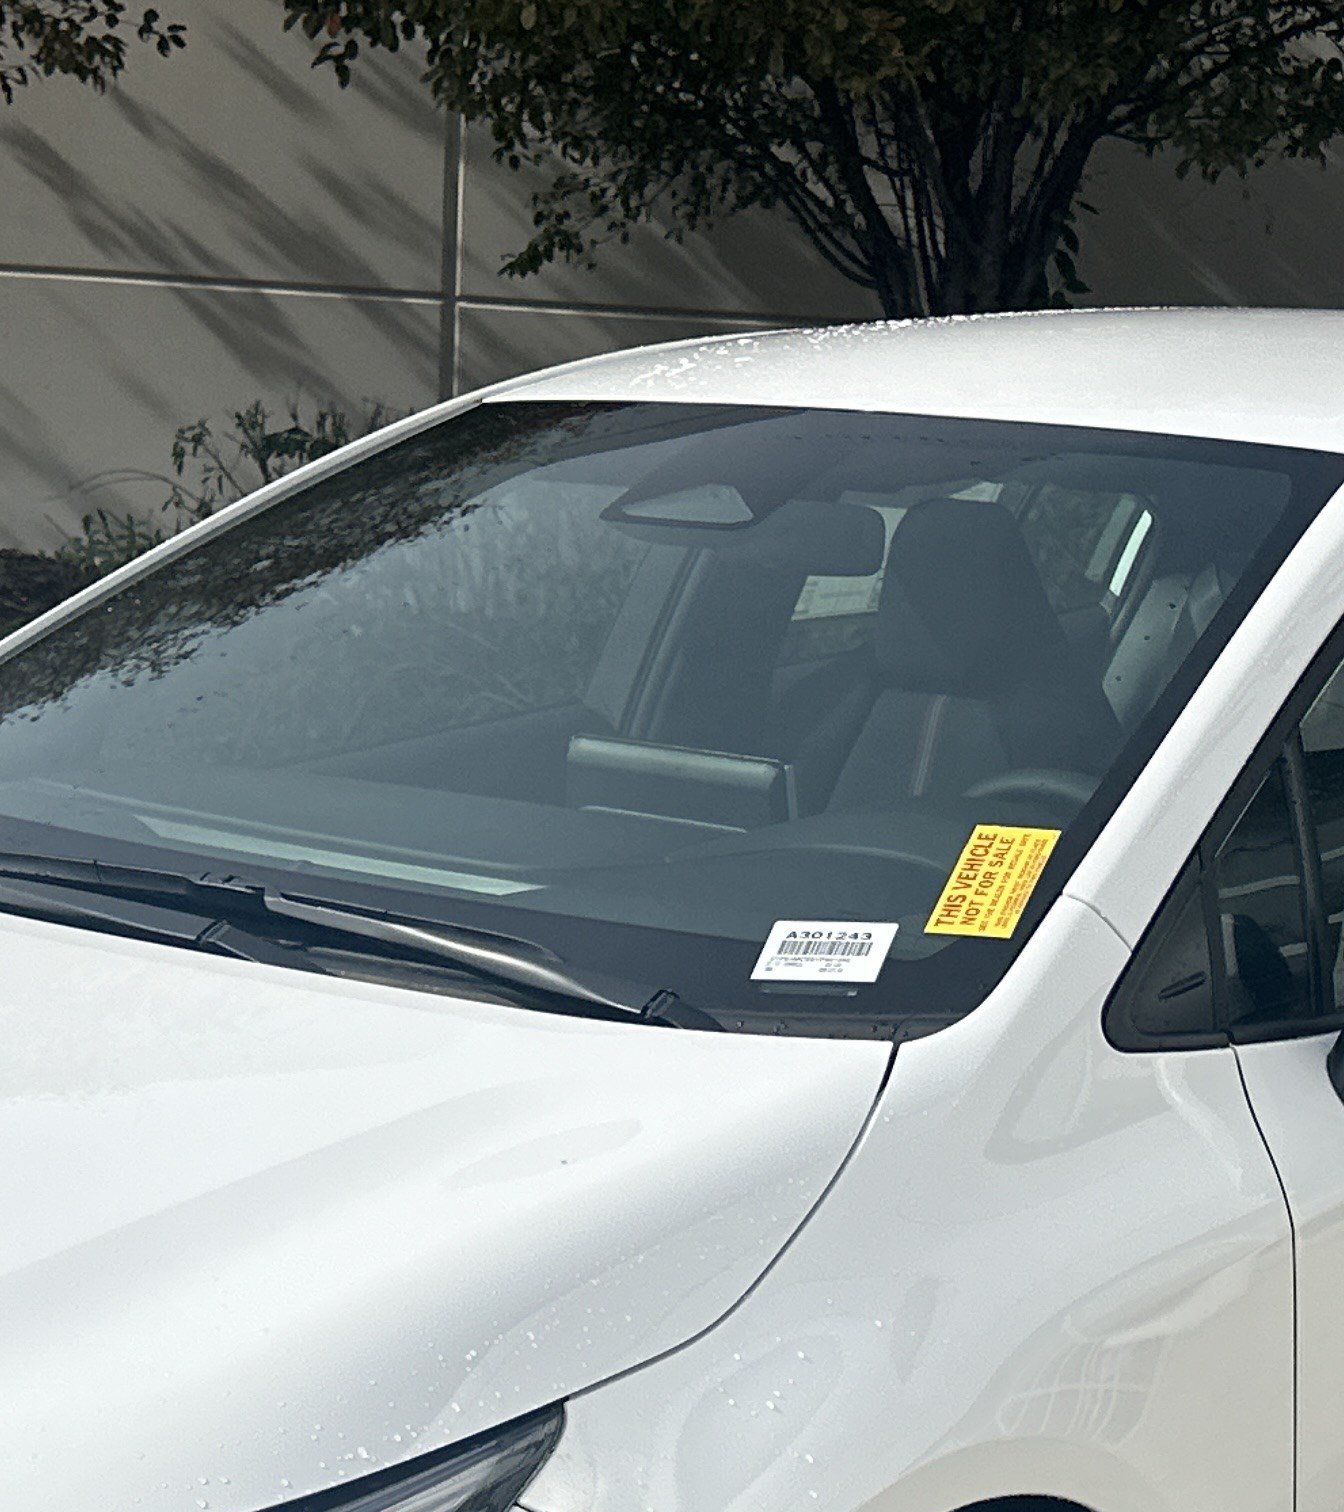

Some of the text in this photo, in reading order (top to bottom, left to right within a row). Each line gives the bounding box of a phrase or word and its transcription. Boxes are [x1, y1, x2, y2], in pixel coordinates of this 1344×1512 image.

[934, 832, 998, 927] THIS VEHICLE
[960, 837, 1015, 925] NOT FOR SALE
